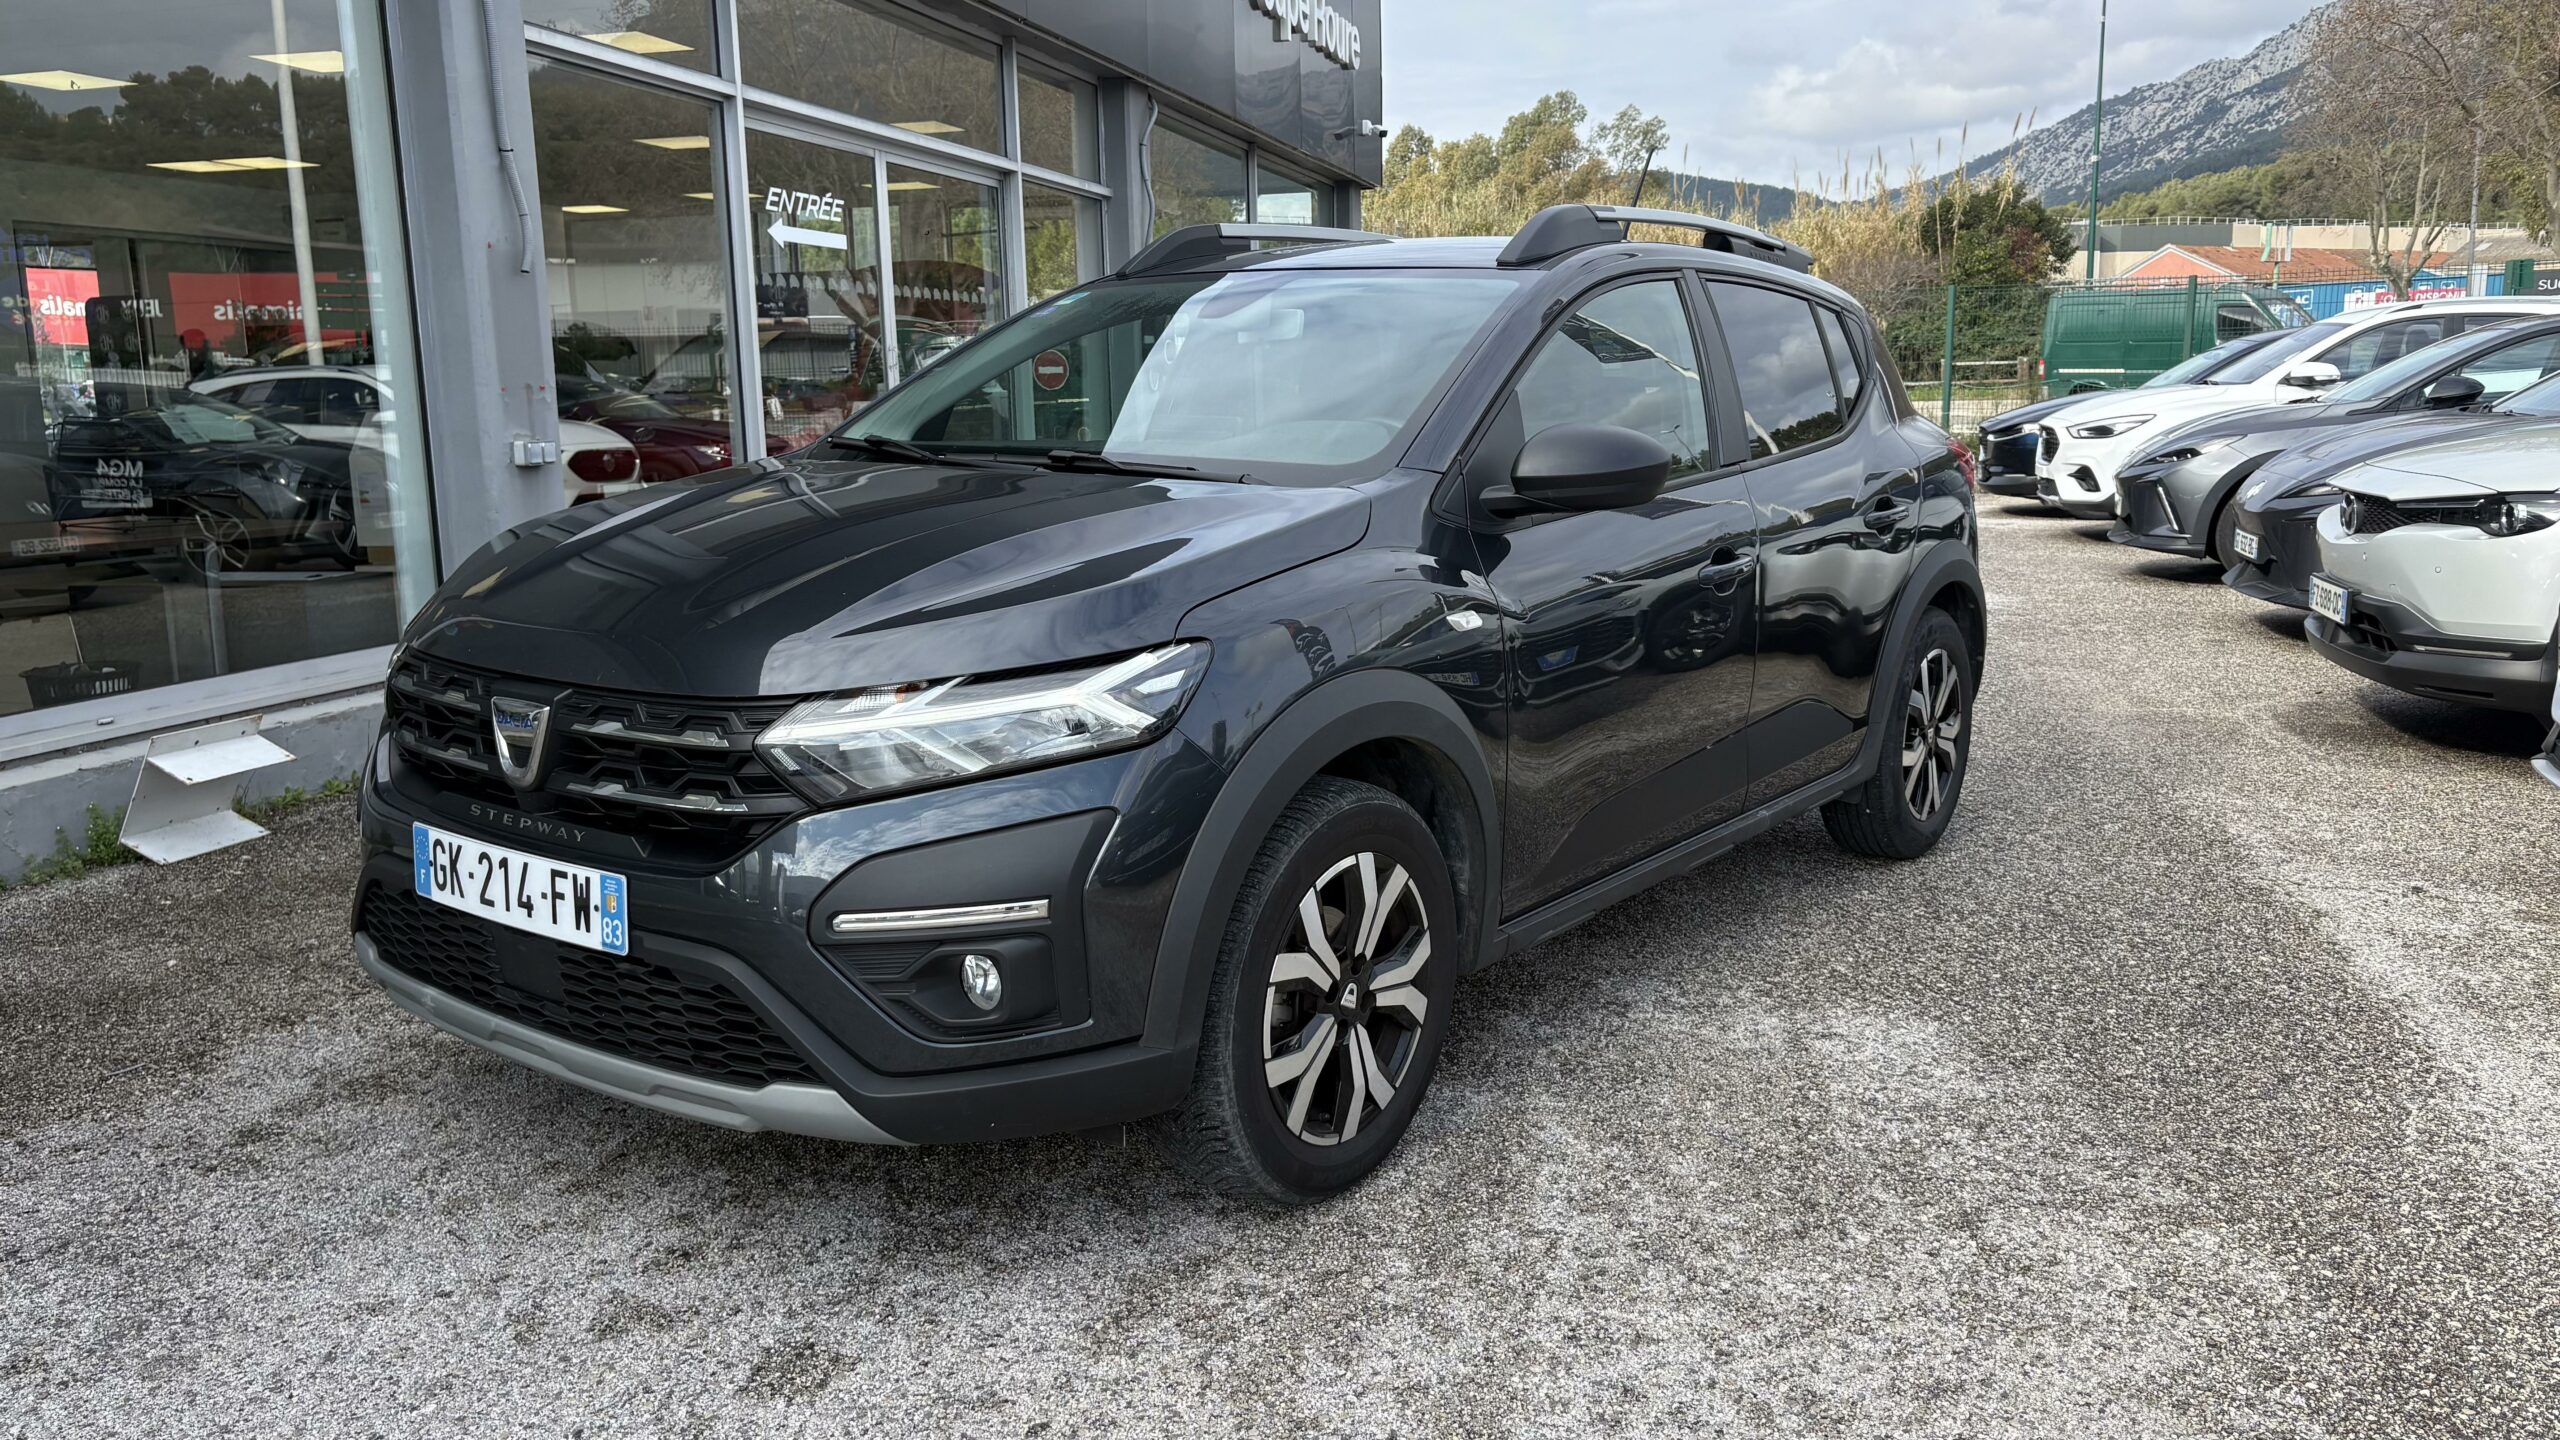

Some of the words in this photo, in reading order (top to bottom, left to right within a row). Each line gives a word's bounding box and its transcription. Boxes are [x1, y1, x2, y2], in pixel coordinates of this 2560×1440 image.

[765, 187, 845, 223] ENTRÉE
[2537, 278, 2560, 290] SU
[469, 804, 586, 842] STEPWAY
[421, 868, 426, 884] F
[432, 838, 591, 933] GK-214-FW
[602, 917, 623, 946] 83
